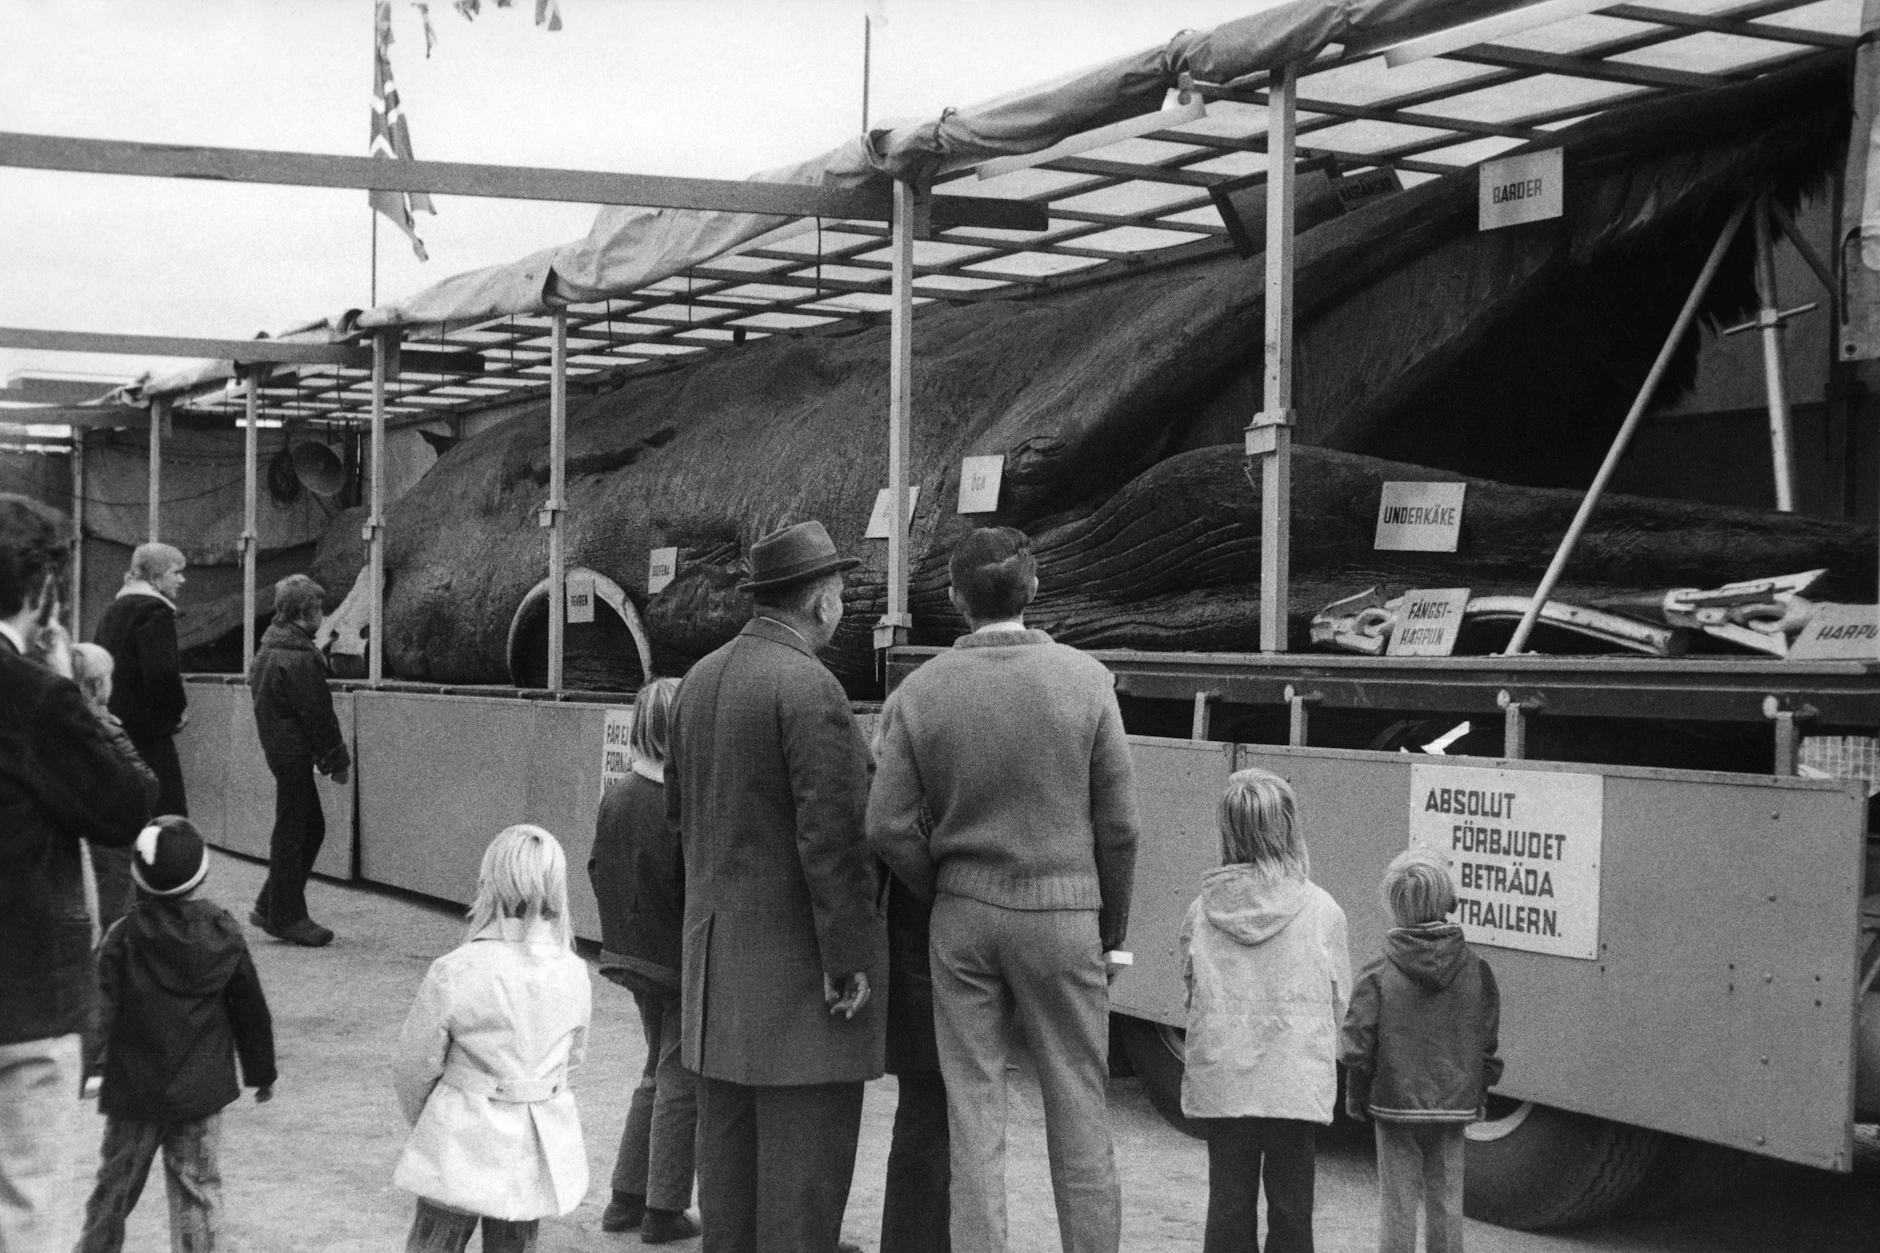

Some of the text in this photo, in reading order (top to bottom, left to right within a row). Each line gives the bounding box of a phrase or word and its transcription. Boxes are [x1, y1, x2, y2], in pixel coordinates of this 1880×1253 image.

[1493, 178, 1543, 205] BARDER
[1383, 503, 1456, 526] UNDERKÄKE
[1408, 598, 1452, 620] FÅNGST-
[1400, 627, 1445, 646] HARPUN
[1425, 787, 1516, 819] ABSOLUT
[1452, 820, 1566, 861] FÖRBJUDET
[1461, 862, 1555, 898] BETRÄDA
[1458, 898, 1563, 938] TRAILERN.
